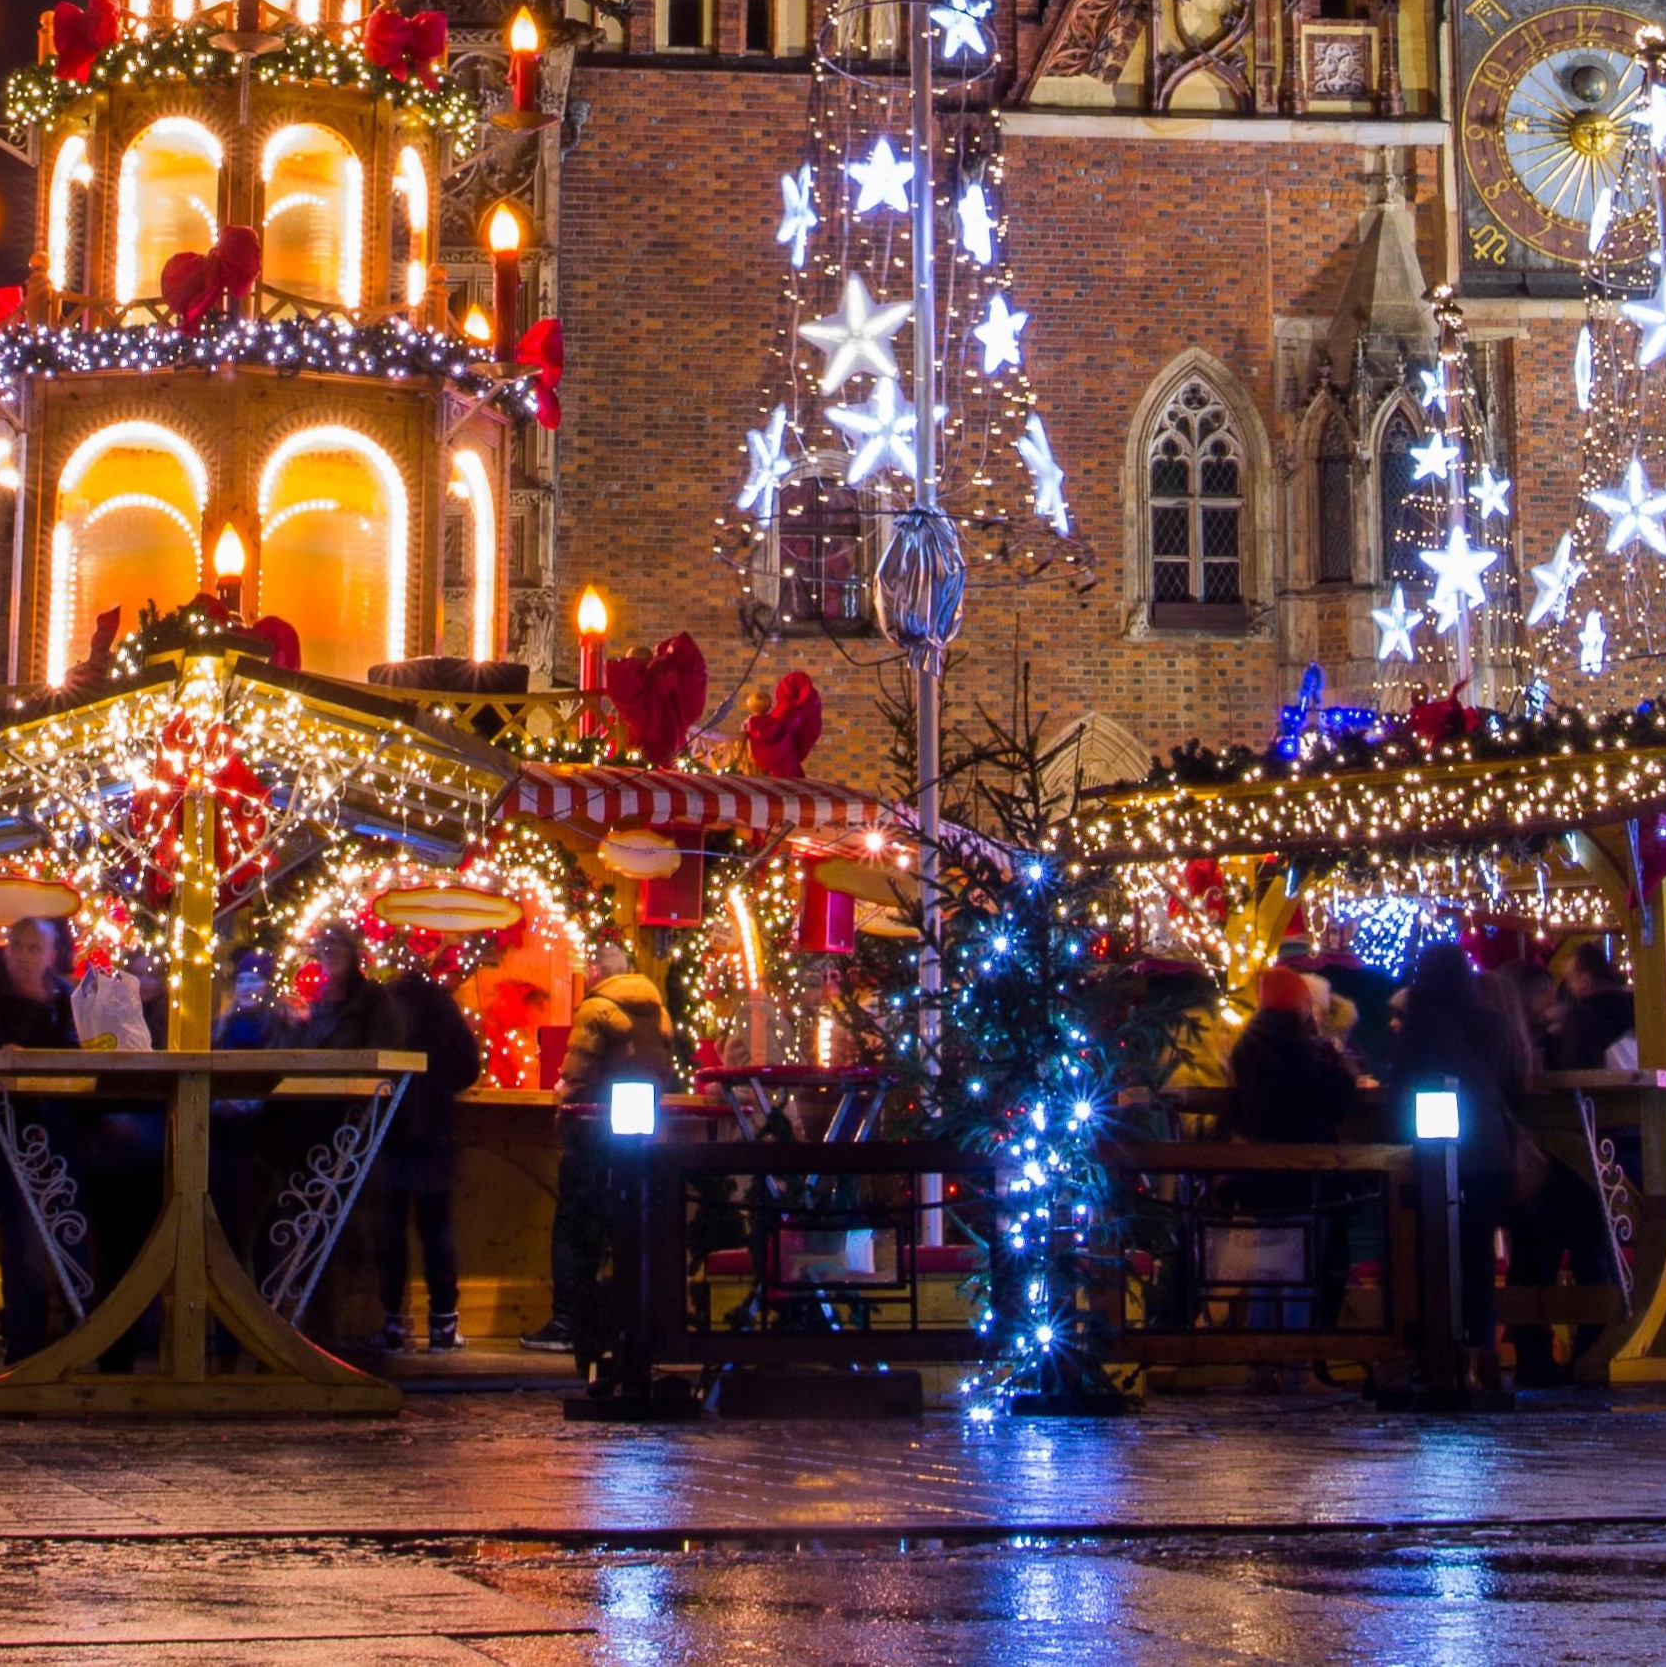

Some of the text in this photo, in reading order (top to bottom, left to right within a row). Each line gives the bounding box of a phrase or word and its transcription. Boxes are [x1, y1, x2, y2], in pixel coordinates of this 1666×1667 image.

[1576, 11, 1603, 37] 12
[1521, 23, 1546, 53] 11
[1479, 61, 1510, 94] 10
[1466, 124, 1495, 142] 9
[1484, 180, 1510, 200] 8
[1528, 220, 1553, 247] 7
